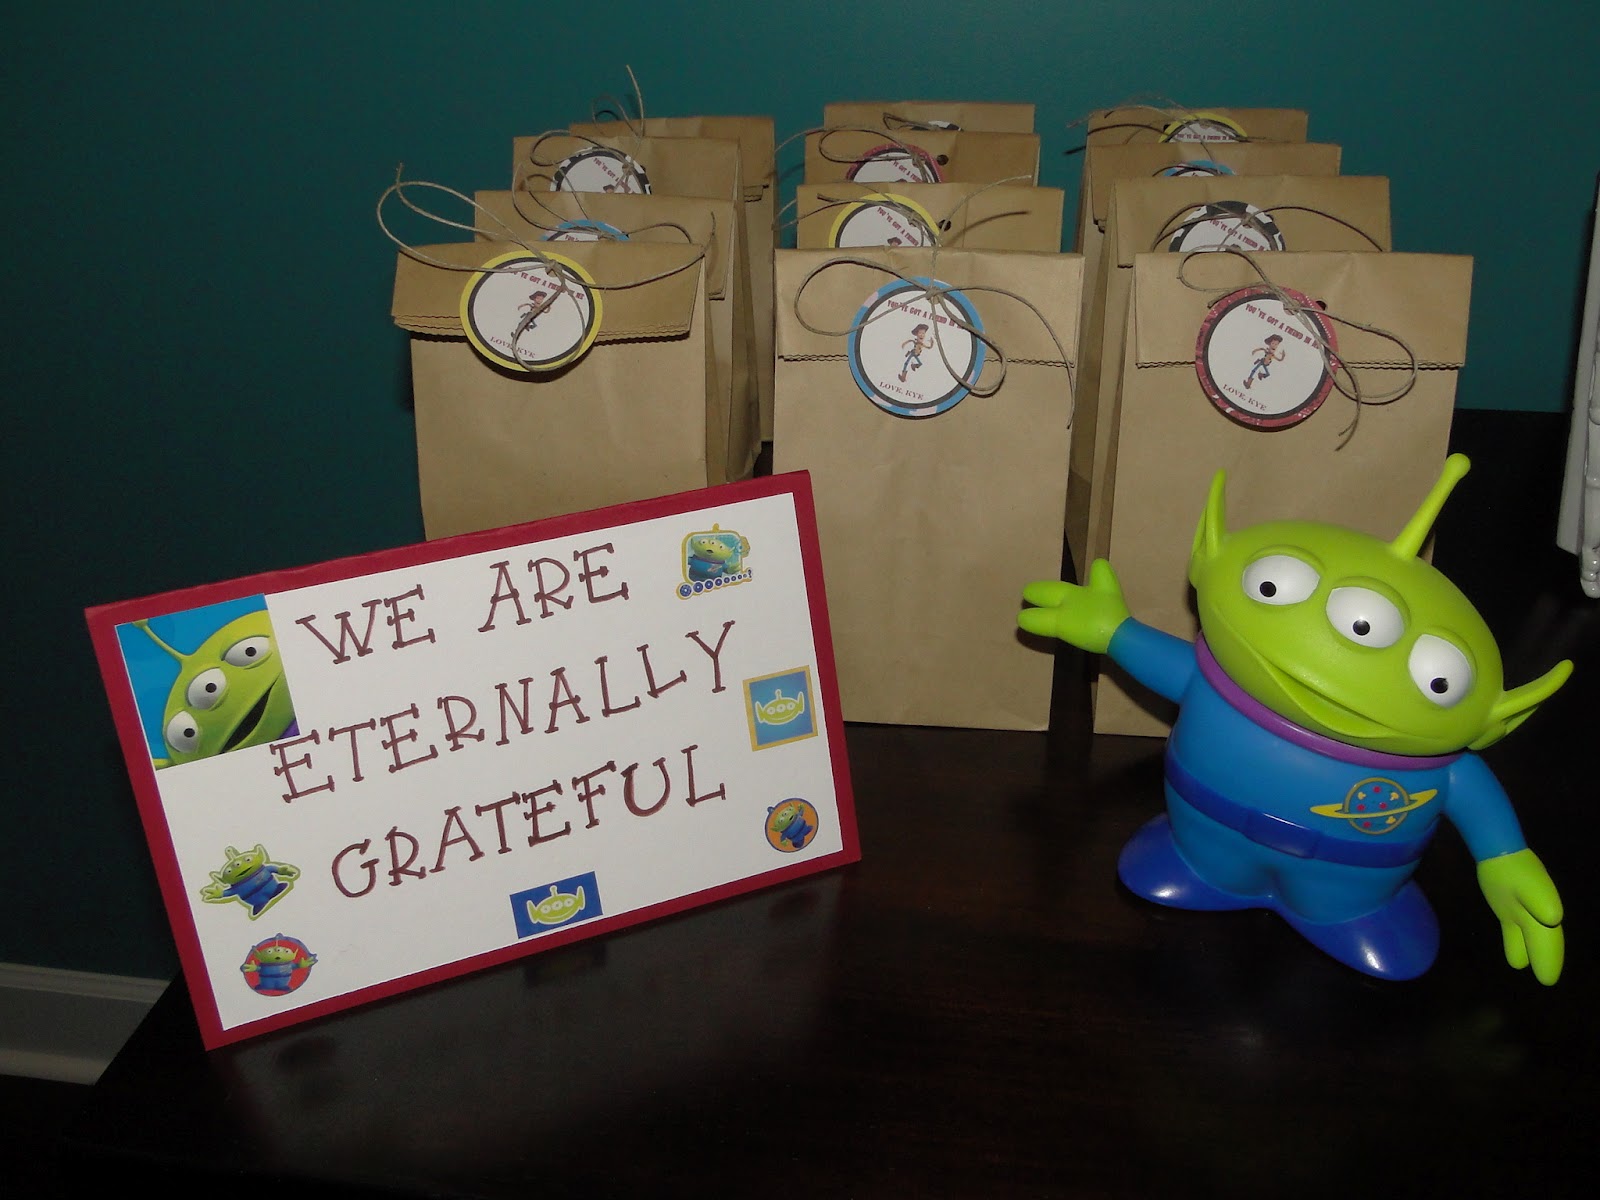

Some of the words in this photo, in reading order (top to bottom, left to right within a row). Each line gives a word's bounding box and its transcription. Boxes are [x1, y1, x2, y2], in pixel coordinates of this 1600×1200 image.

[910, 307, 922, 316] GOT
[1266, 316, 1278, 326] GOT
[1284, 326, 1304, 340] FRIEND
[1248, 398, 1267, 410] KYE
[297, 584, 434, 665] WE
[478, 541, 629, 633] ARE
[270, 620, 735, 803] ETERNALLY
[331, 745, 726, 898] GRATEFUL
